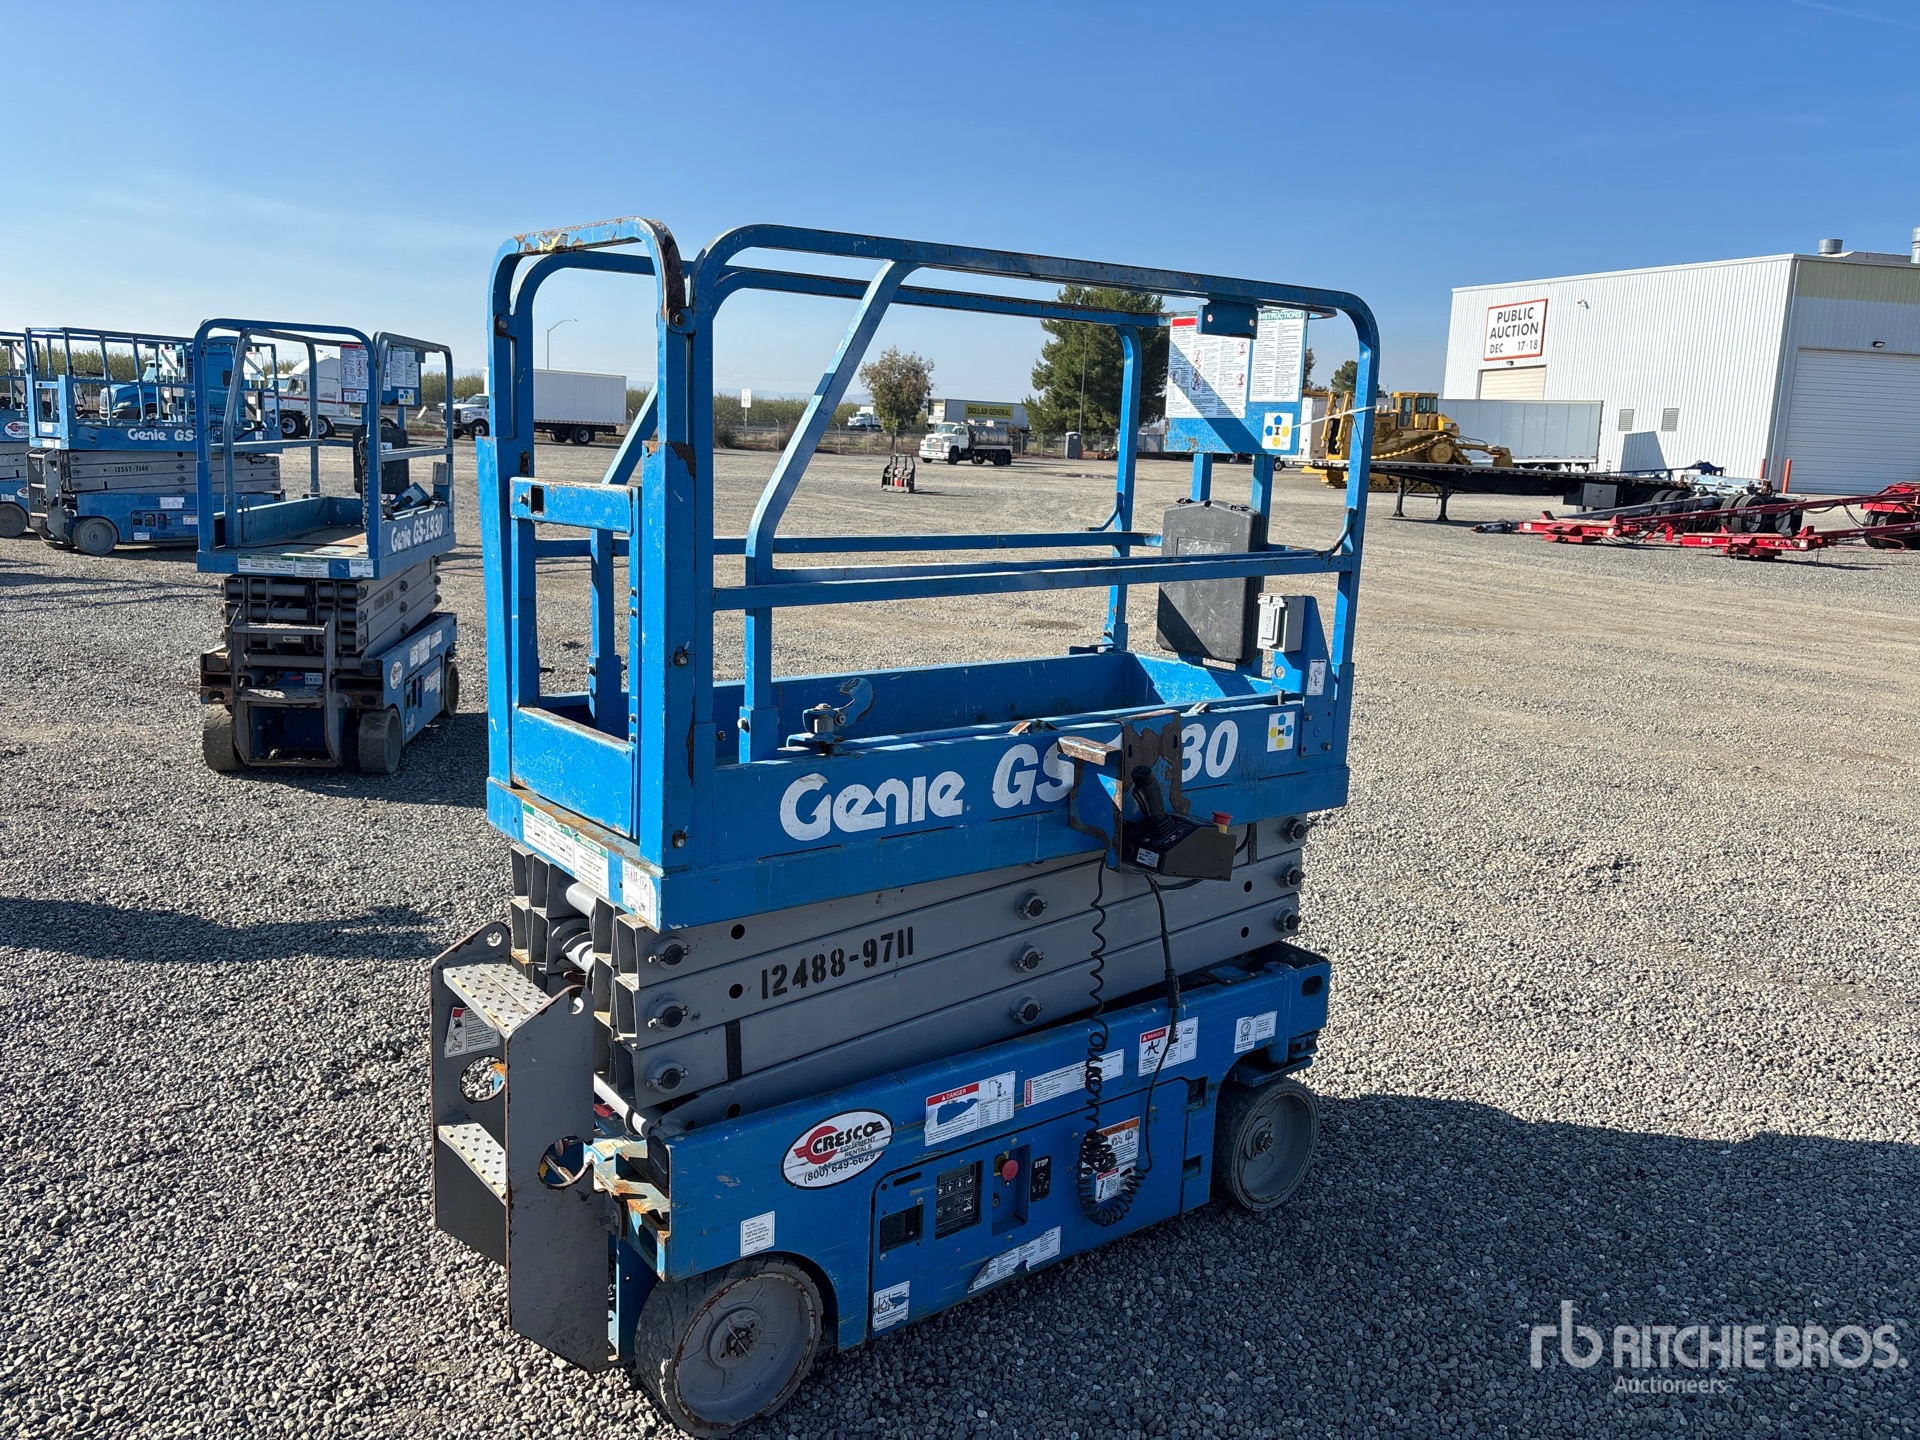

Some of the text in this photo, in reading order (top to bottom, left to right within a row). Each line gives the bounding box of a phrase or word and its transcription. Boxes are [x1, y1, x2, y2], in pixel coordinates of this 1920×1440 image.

[1497, 307, 1534, 323] PUBLIC
[1490, 322, 1538, 339] AUCTION
[1490, 340, 1538, 354] DEC 17-18
[128, 428, 166, 440] Genie
[392, 513, 442, 552] Genie GS-1930
[780, 770, 966, 842] Genie
[762, 926, 914, 1000] 12488-9711
[946, 1088, 966, 1100] DANGER
[812, 1121, 880, 1154] CRESCO
[844, 1144, 872, 1158] RENTALS
[1034, 1158, 1048, 1168] STOP
[804, 1166, 828, 1184] (800)
